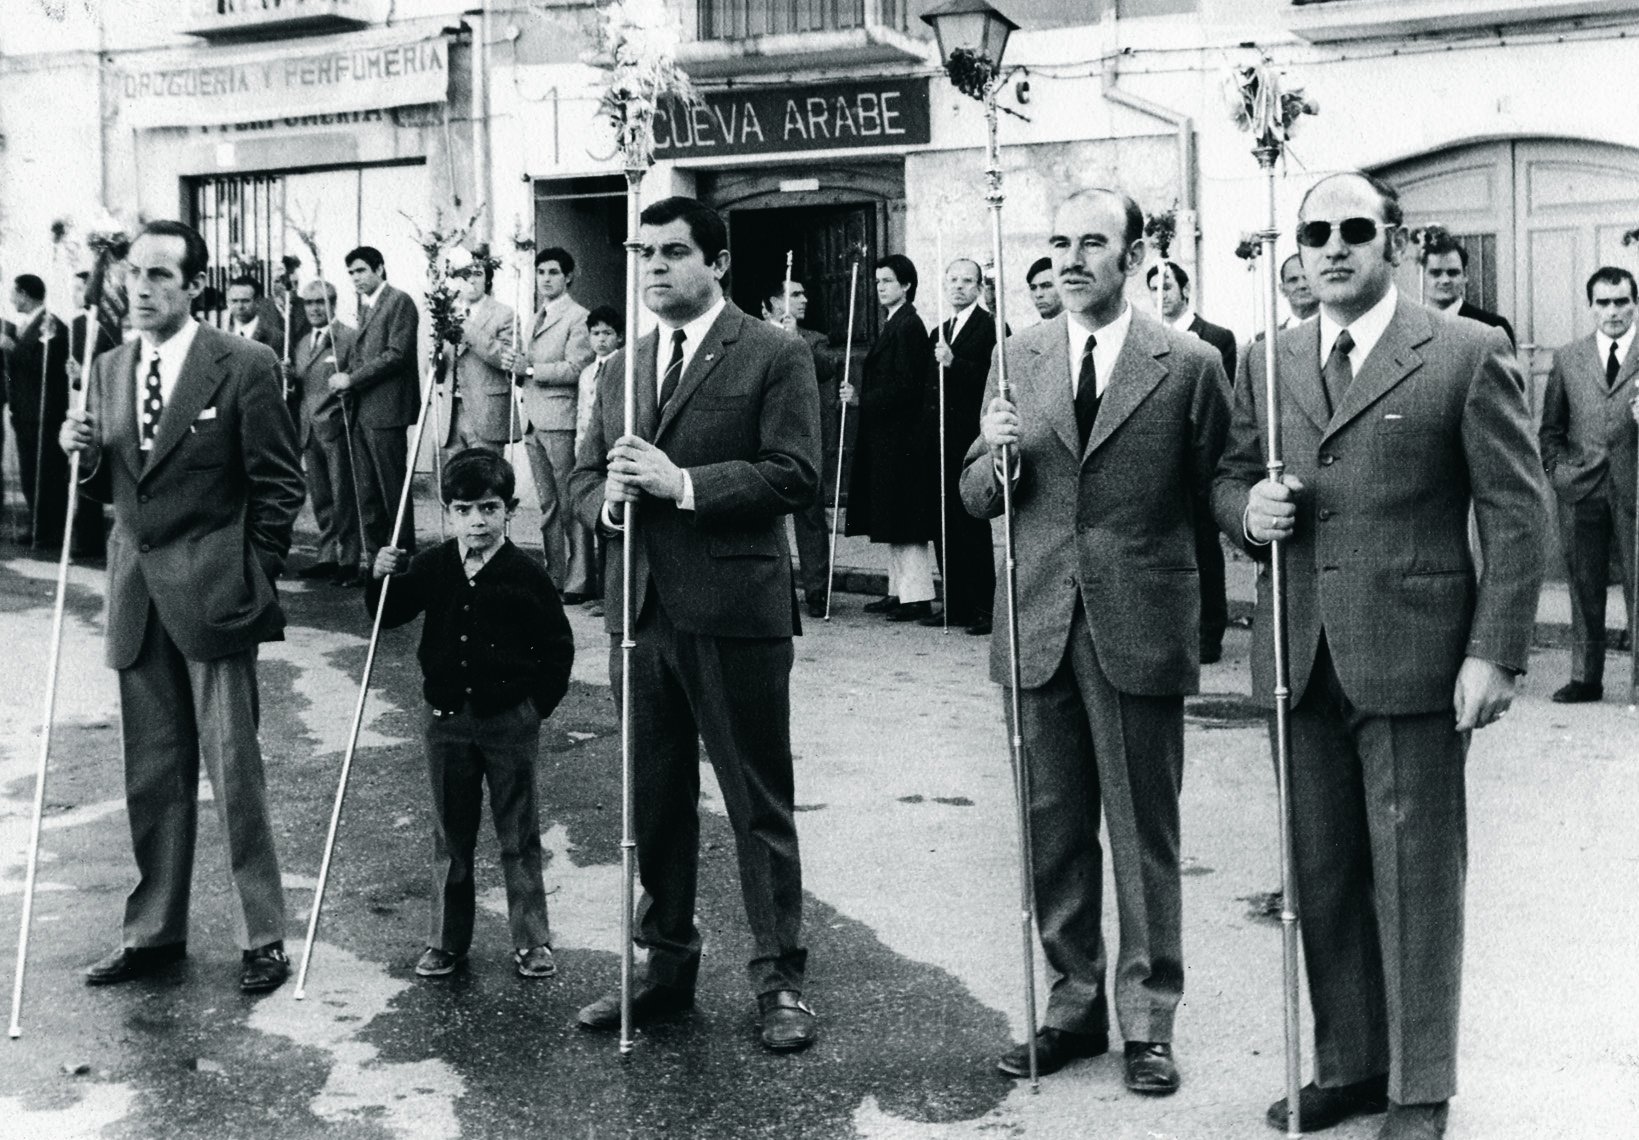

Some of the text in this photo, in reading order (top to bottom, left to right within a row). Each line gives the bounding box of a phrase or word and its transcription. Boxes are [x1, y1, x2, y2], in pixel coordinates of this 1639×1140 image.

[262, 63, 274, 89] Y
[284, 45, 442, 87] PERFUMERIA
[651, 91, 906, 149] CUEVA ARABE
